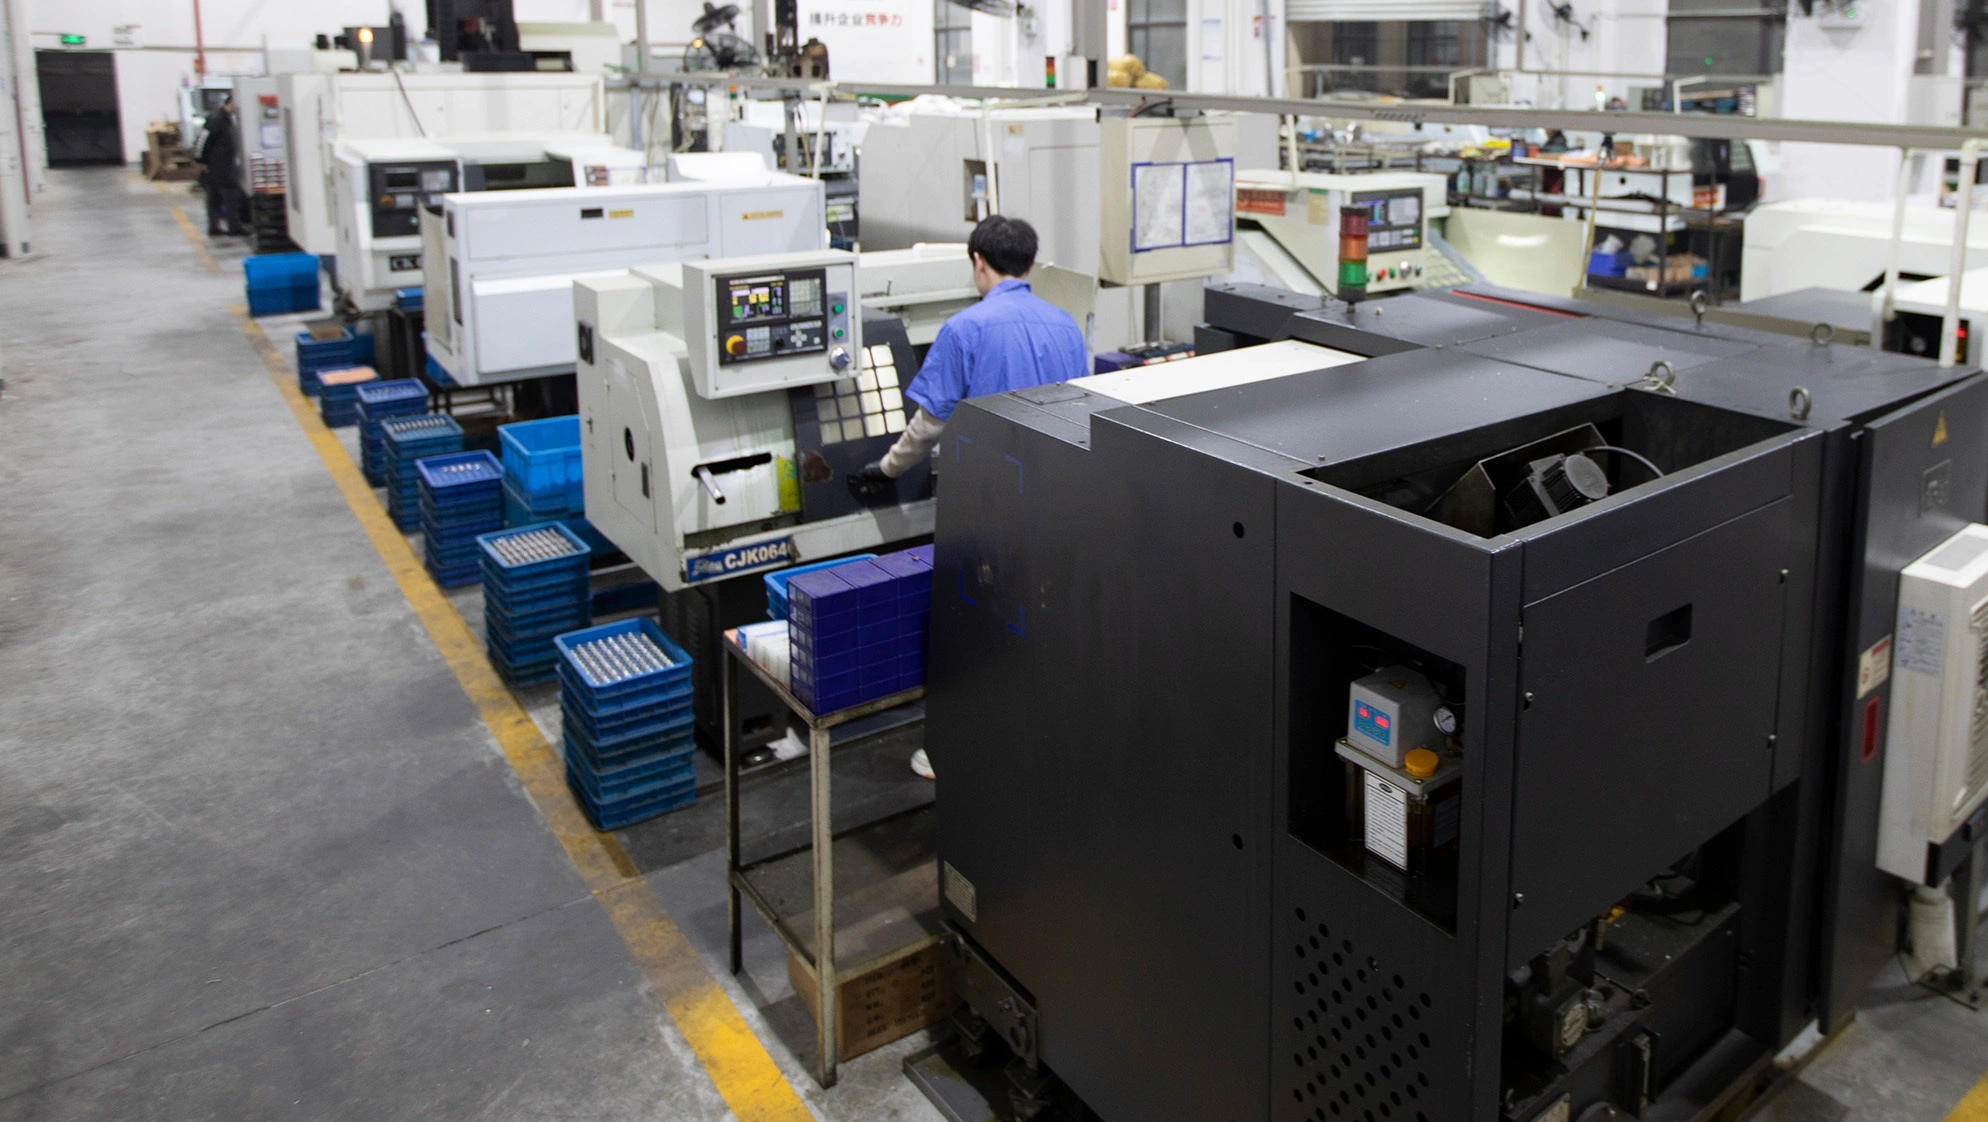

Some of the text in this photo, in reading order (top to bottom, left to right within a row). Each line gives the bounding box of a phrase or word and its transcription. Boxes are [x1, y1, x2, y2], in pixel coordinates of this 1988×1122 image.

[809, 12, 902, 27] 提升企业竞争力
